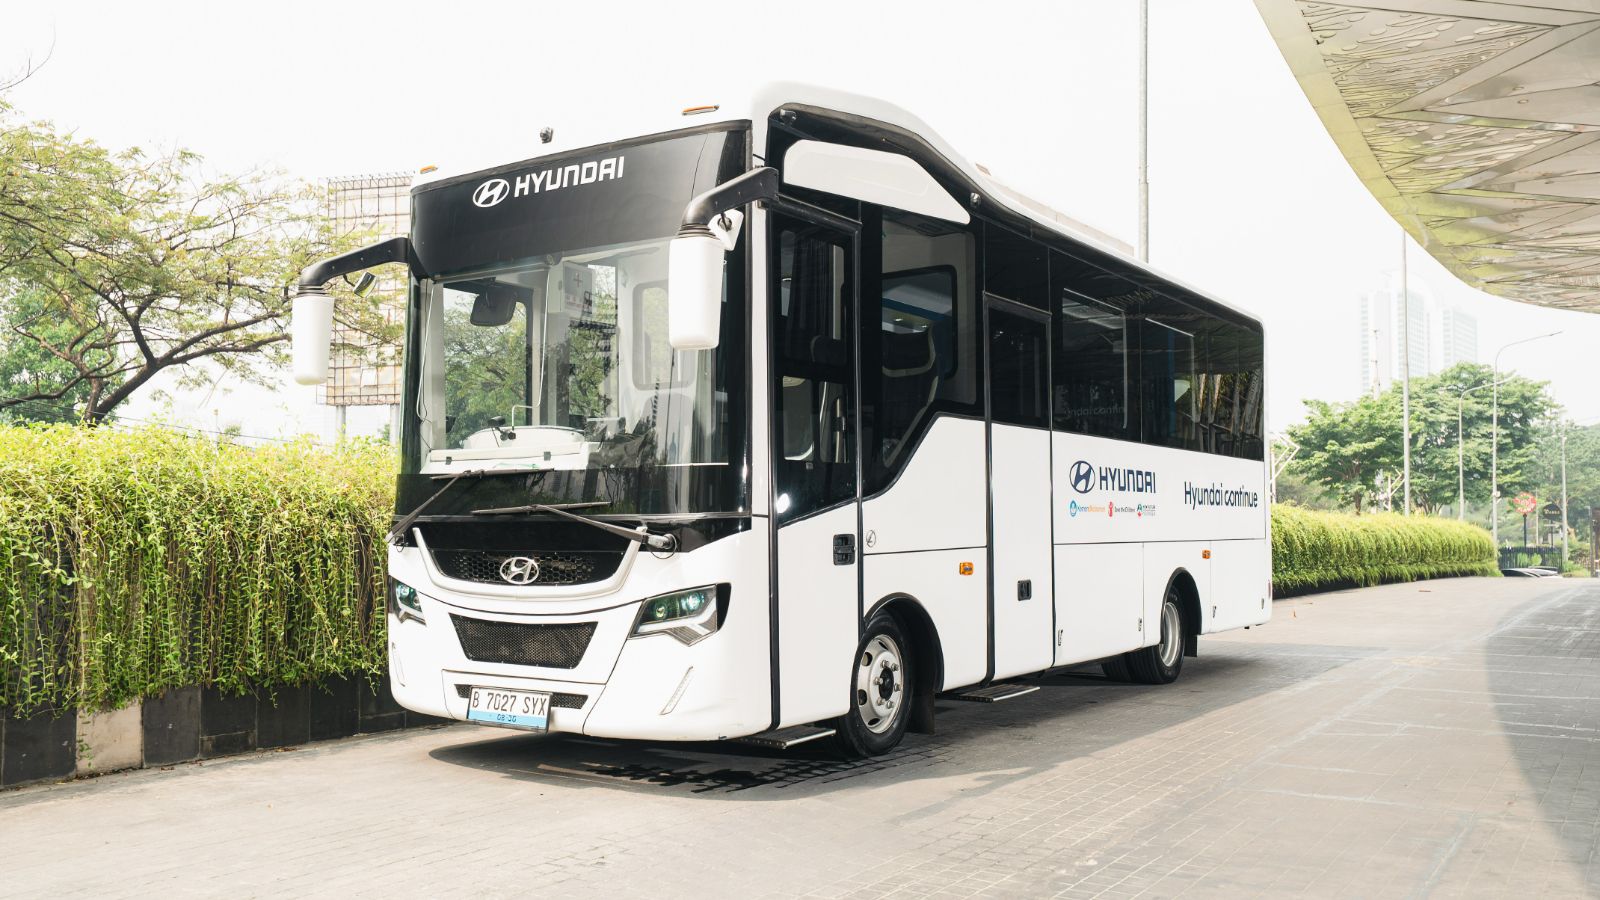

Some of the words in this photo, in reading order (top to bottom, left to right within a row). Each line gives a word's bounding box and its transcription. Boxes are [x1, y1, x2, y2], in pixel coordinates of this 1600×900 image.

[514, 156, 625, 197] HYUNDAI
[1099, 466, 1156, 493] HYUNDAI
[1184, 481, 1223, 510] Hyundai
[1224, 486, 1258, 508] continue
[472, 691, 480, 708] B
[487, 692, 517, 711] 7027
[522, 696, 547, 716] SYX
